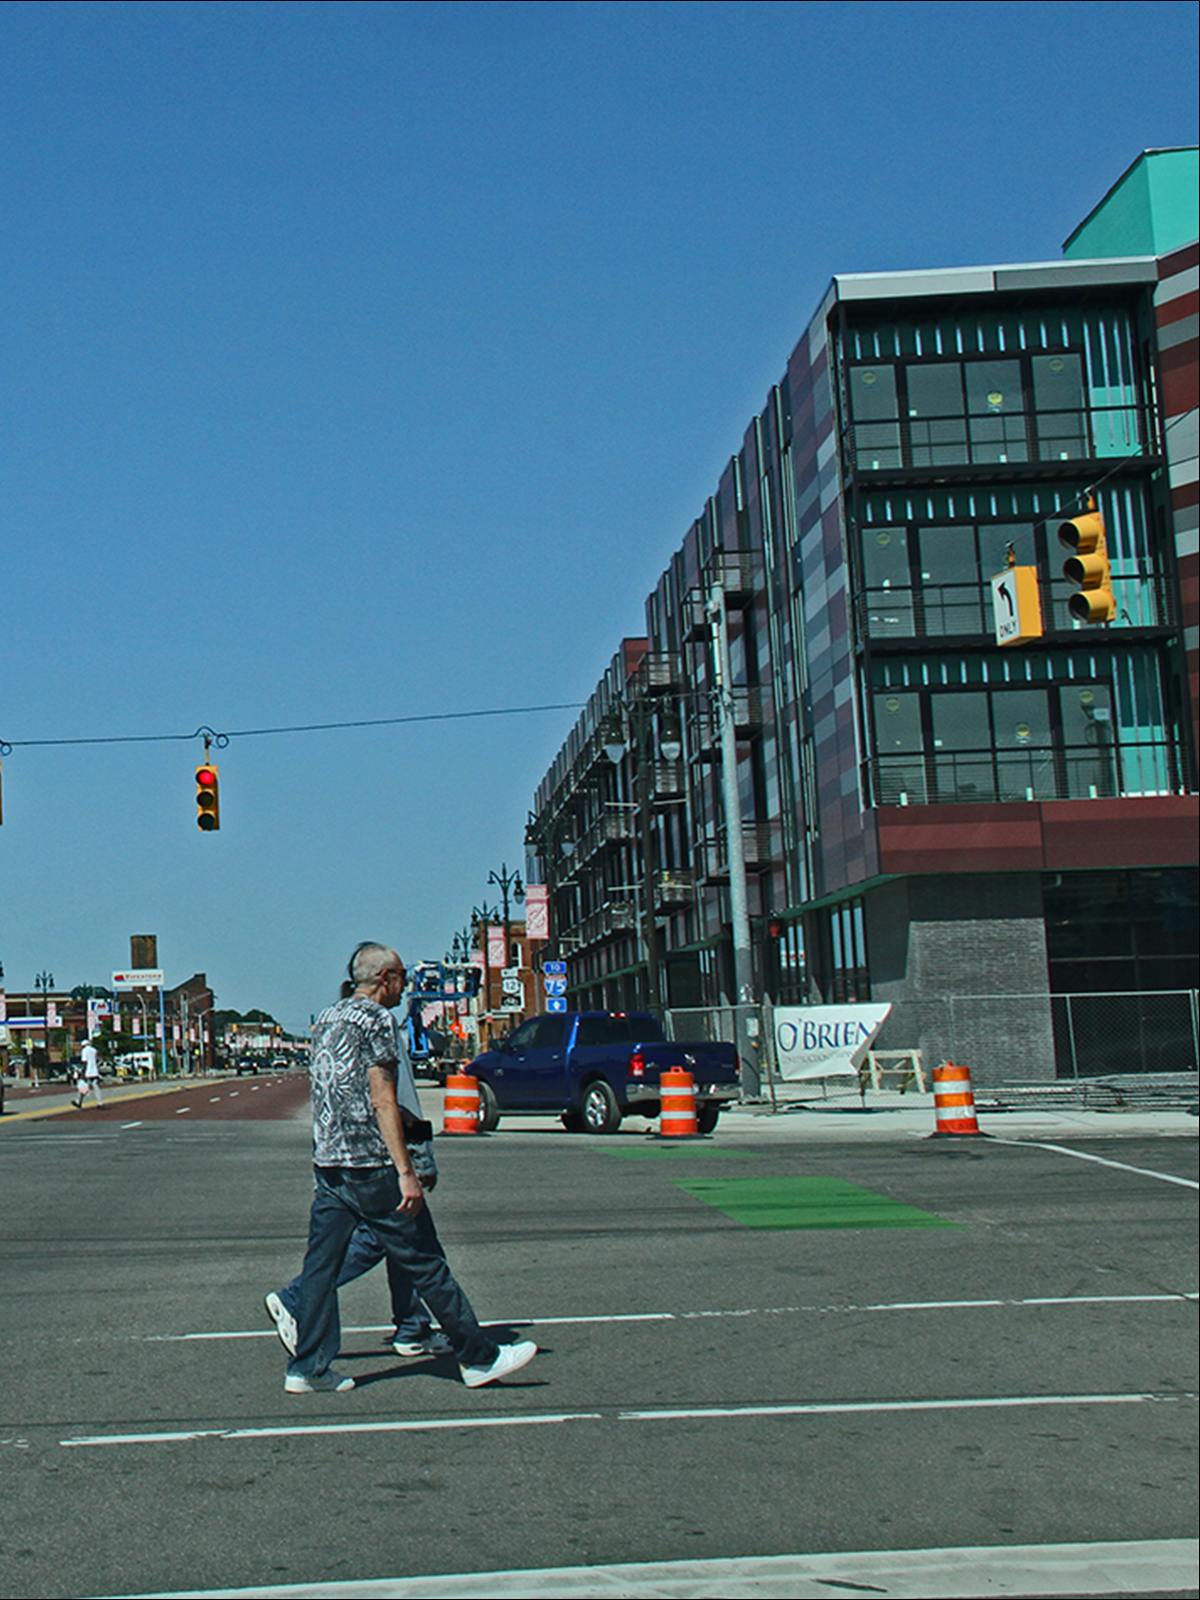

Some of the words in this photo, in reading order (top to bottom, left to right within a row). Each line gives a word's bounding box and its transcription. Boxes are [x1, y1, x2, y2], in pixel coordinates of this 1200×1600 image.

[1000, 620, 1016, 638] ONLY
[505, 981, 517, 991] 12
[546, 980, 566, 992] 75
